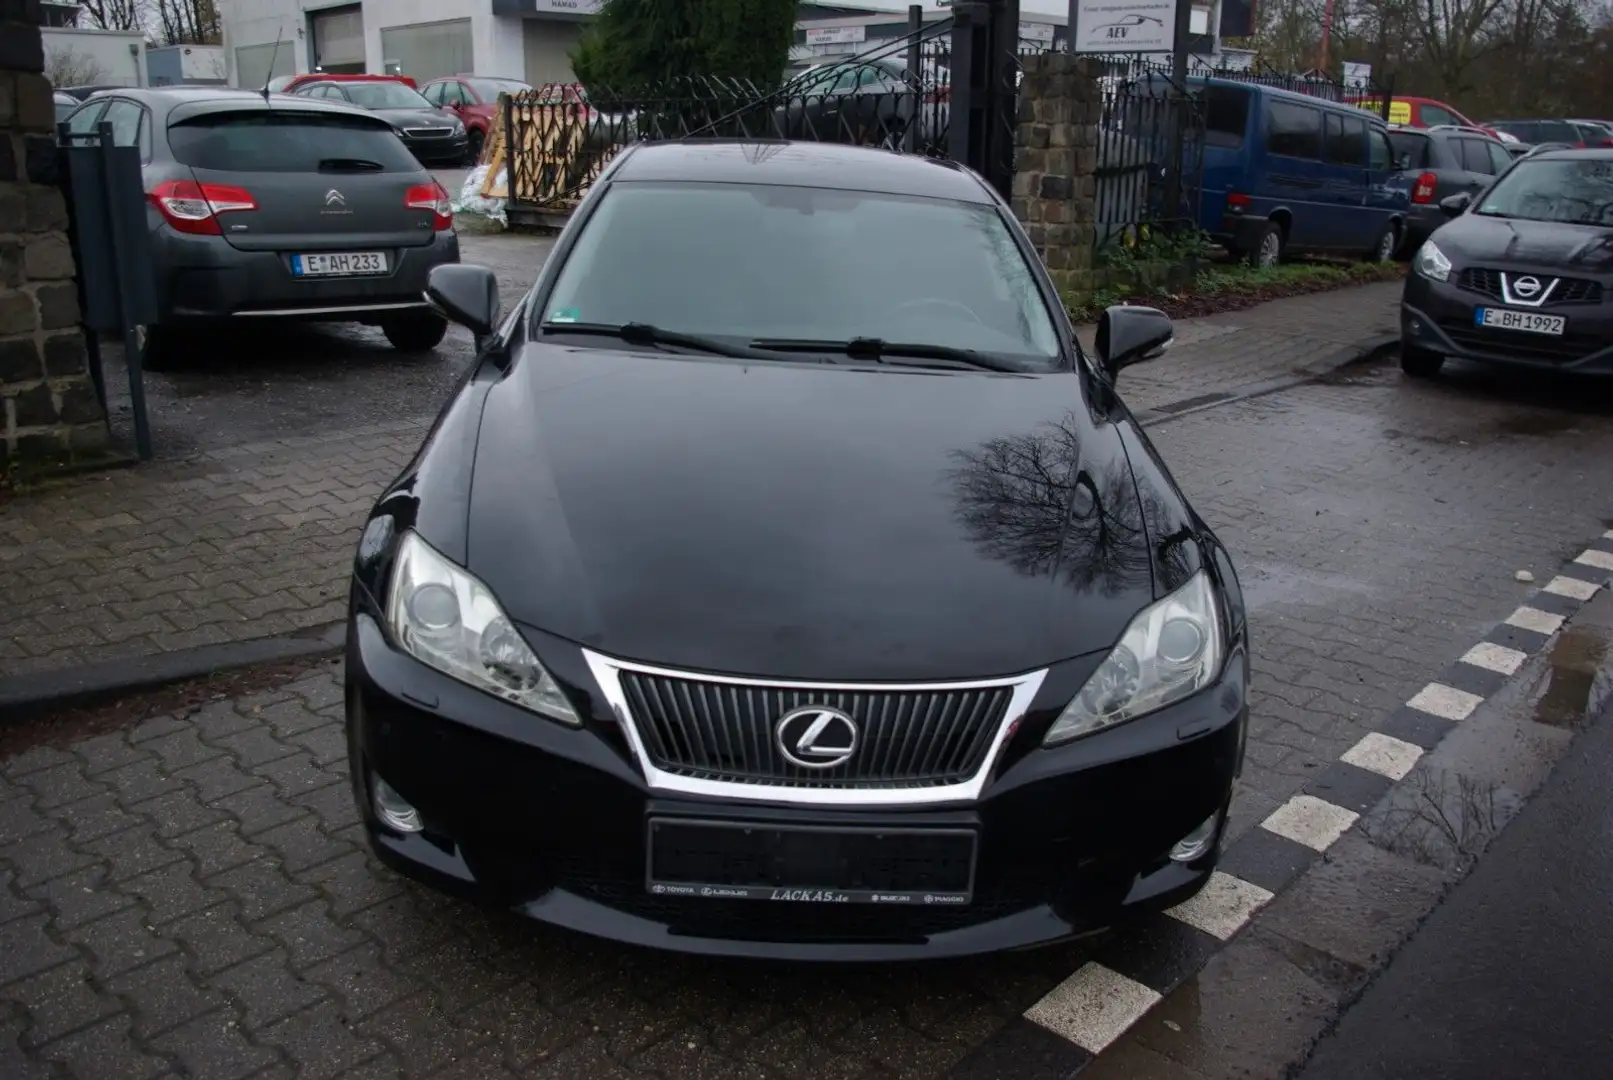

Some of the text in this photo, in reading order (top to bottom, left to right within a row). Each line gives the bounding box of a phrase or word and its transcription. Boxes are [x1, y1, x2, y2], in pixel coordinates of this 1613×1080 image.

[1106, 26, 1129, 38] AEV
[307, 255, 319, 271] E
[1484, 310, 1493, 323] E
[770, 889, 849, 902] LACKAS.de
